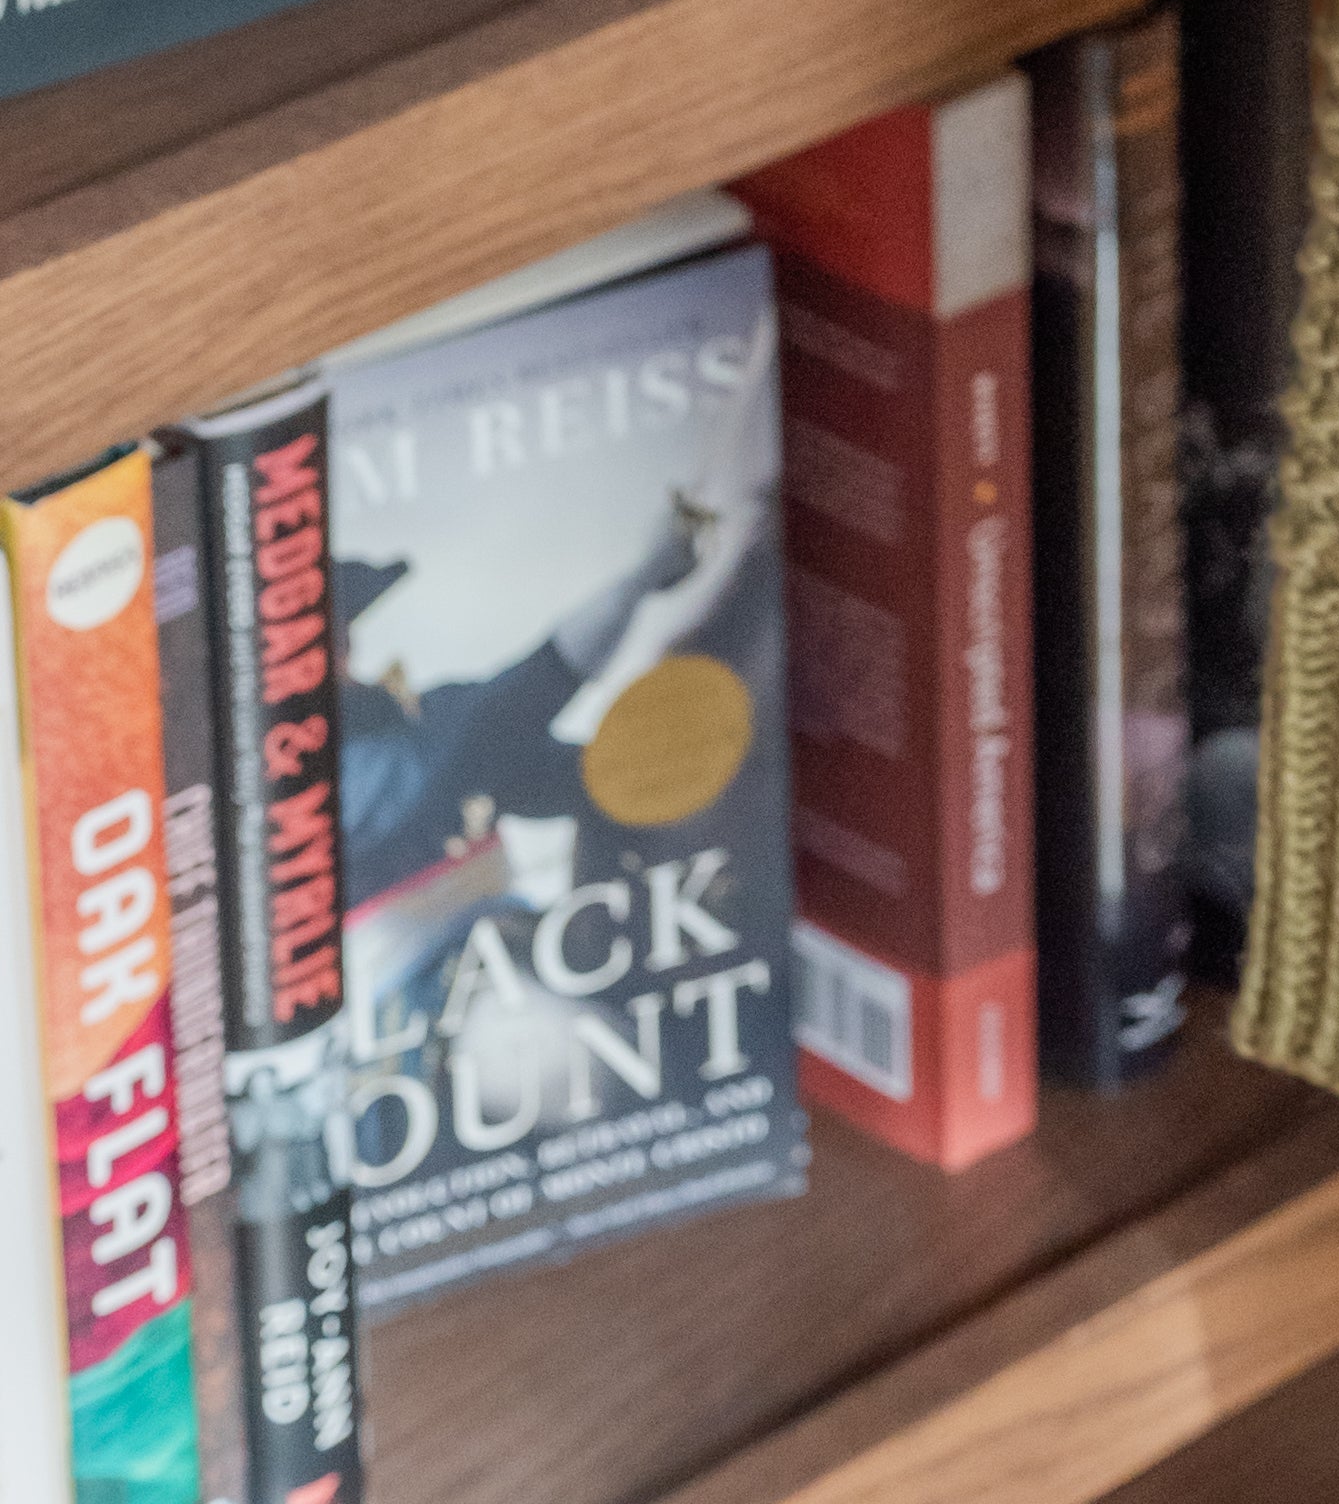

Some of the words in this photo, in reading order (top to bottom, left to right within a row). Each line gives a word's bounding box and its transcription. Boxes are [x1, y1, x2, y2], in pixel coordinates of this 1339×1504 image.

[470, 334, 751, 478] REISS
[254, 433, 329, 705] MEDGAR
[264, 713, 329, 781] &
[72, 788, 161, 1025] OAK
[265, 782, 344, 1024] MYRLIE
[343, 847, 739, 1062] LACK
[85, 1043, 179, 1317] FLAT
[348, 959, 772, 1189] OUNT
[259, 1298, 311, 1426] REID
[306, 1221, 353, 1452] JOY-ANN
